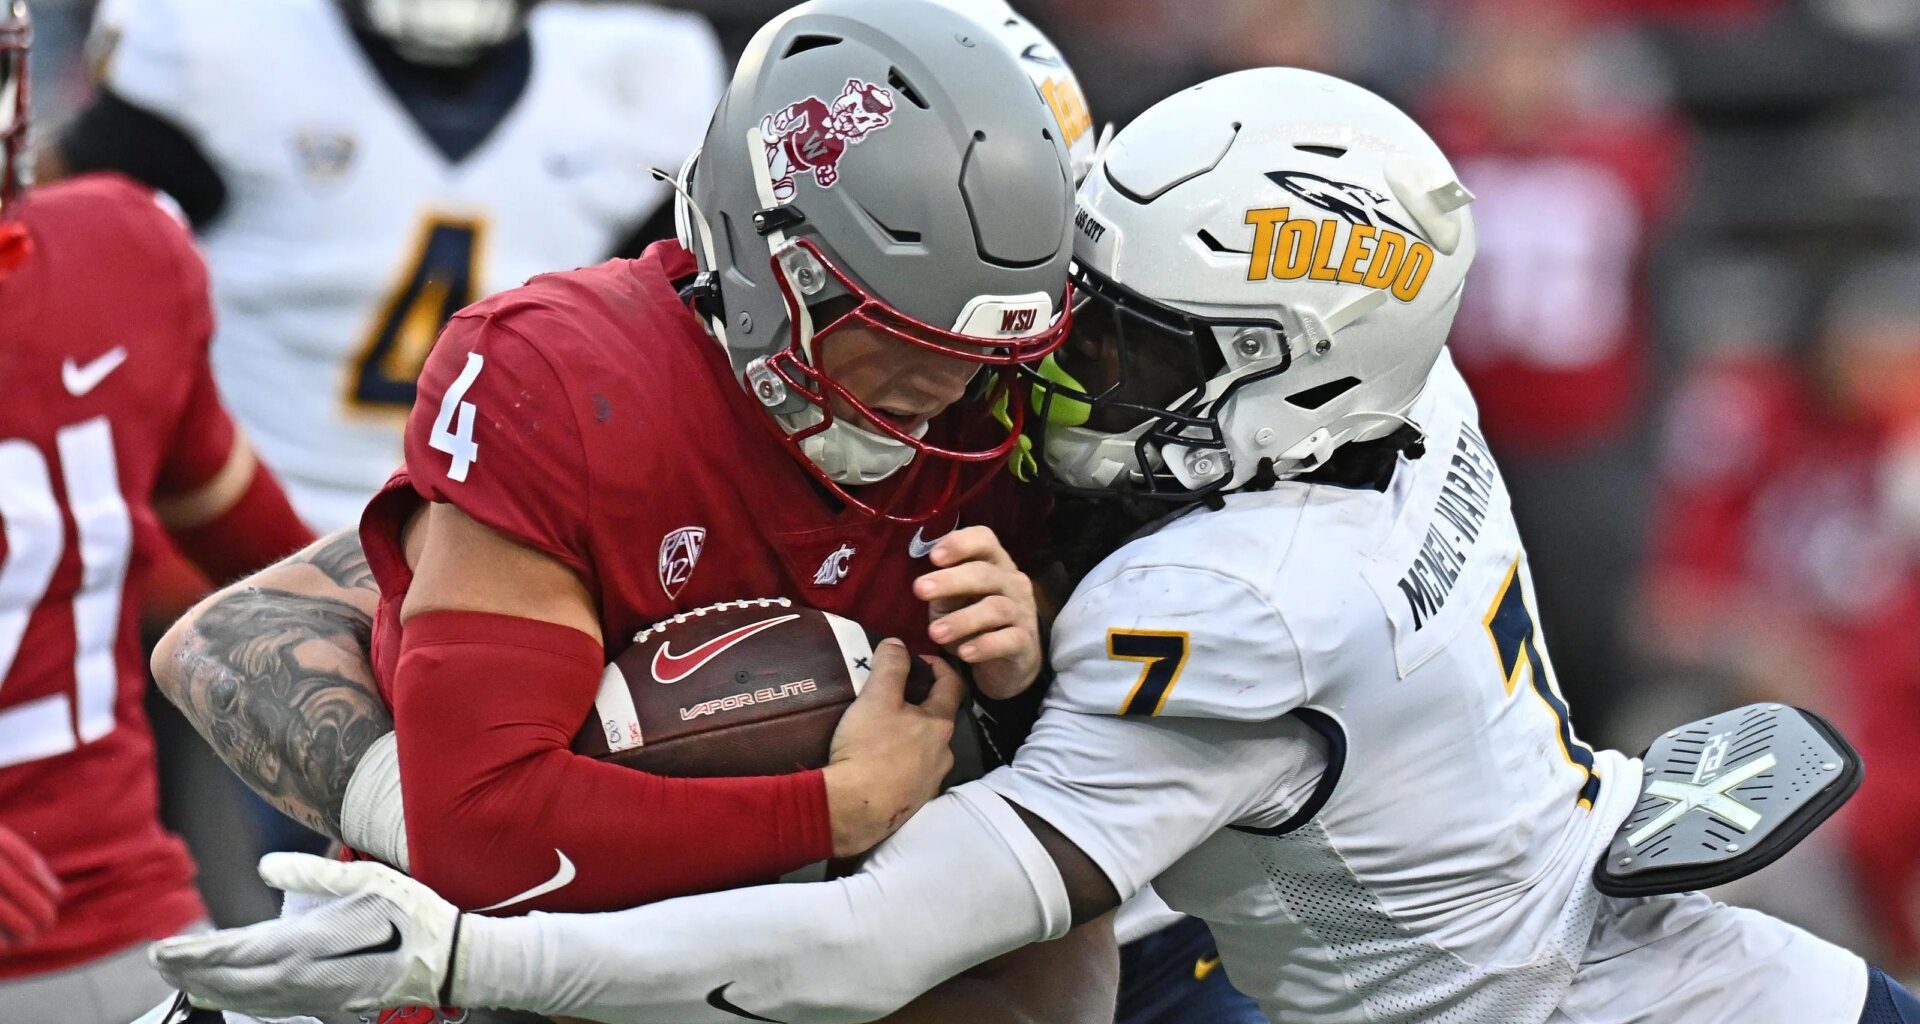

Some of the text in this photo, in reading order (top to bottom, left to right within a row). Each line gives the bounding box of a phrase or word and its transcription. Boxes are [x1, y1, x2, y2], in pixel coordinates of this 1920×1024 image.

[1084, 217, 1106, 243] CITY
[1244, 207, 1434, 302] TOLEDO
[340, 211, 487, 418] 4
[1000, 308, 1038, 331] WSU
[428, 352, 484, 483] 4
[662, 530, 704, 573] PAC
[666, 557, 689, 586] 12
[0, 414, 134, 769] 21
[680, 678, 818, 721] VAPOR ELITE
[1107, 627, 1190, 717] 7
